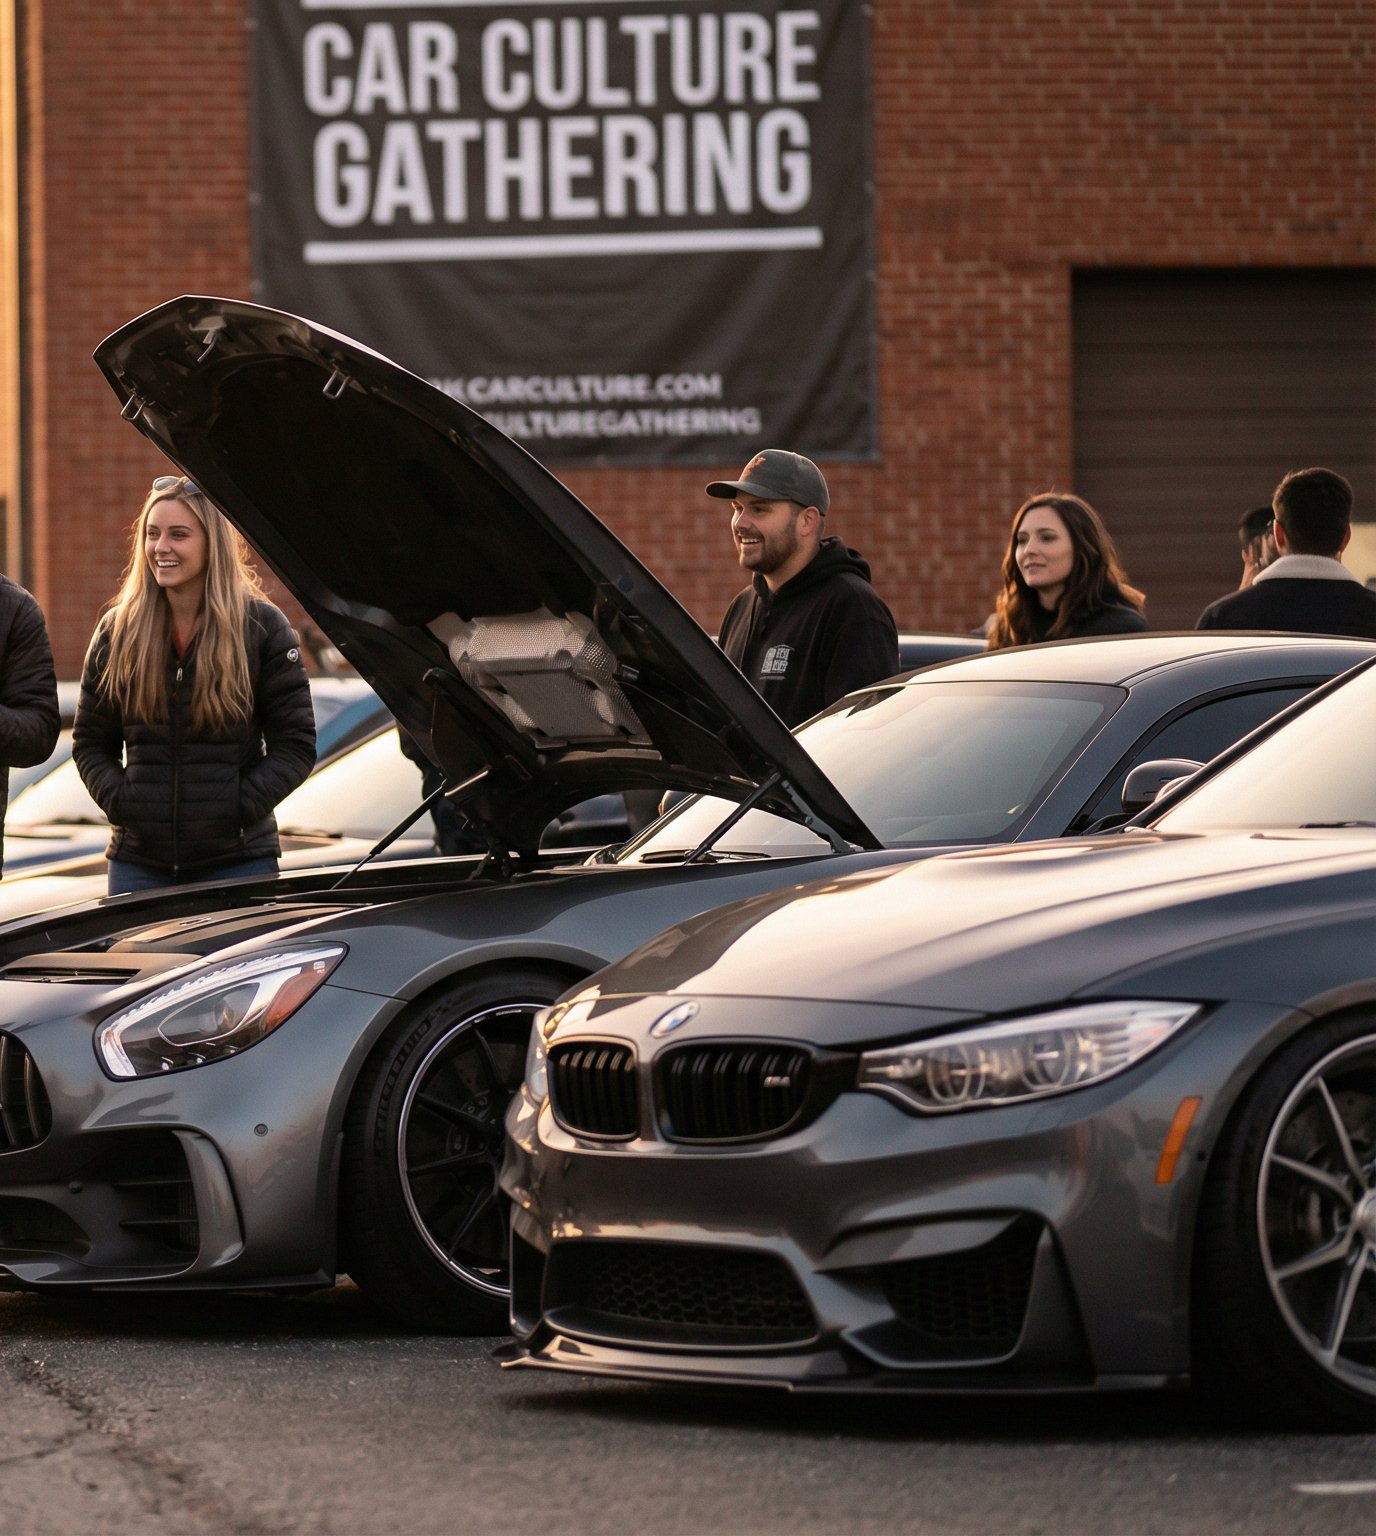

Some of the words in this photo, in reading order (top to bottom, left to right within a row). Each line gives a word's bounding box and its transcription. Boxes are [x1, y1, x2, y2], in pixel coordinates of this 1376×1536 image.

[302, 20, 460, 116] CAR
[480, 9, 821, 112] CULTURE
[312, 107, 812, 228] GATHERING
